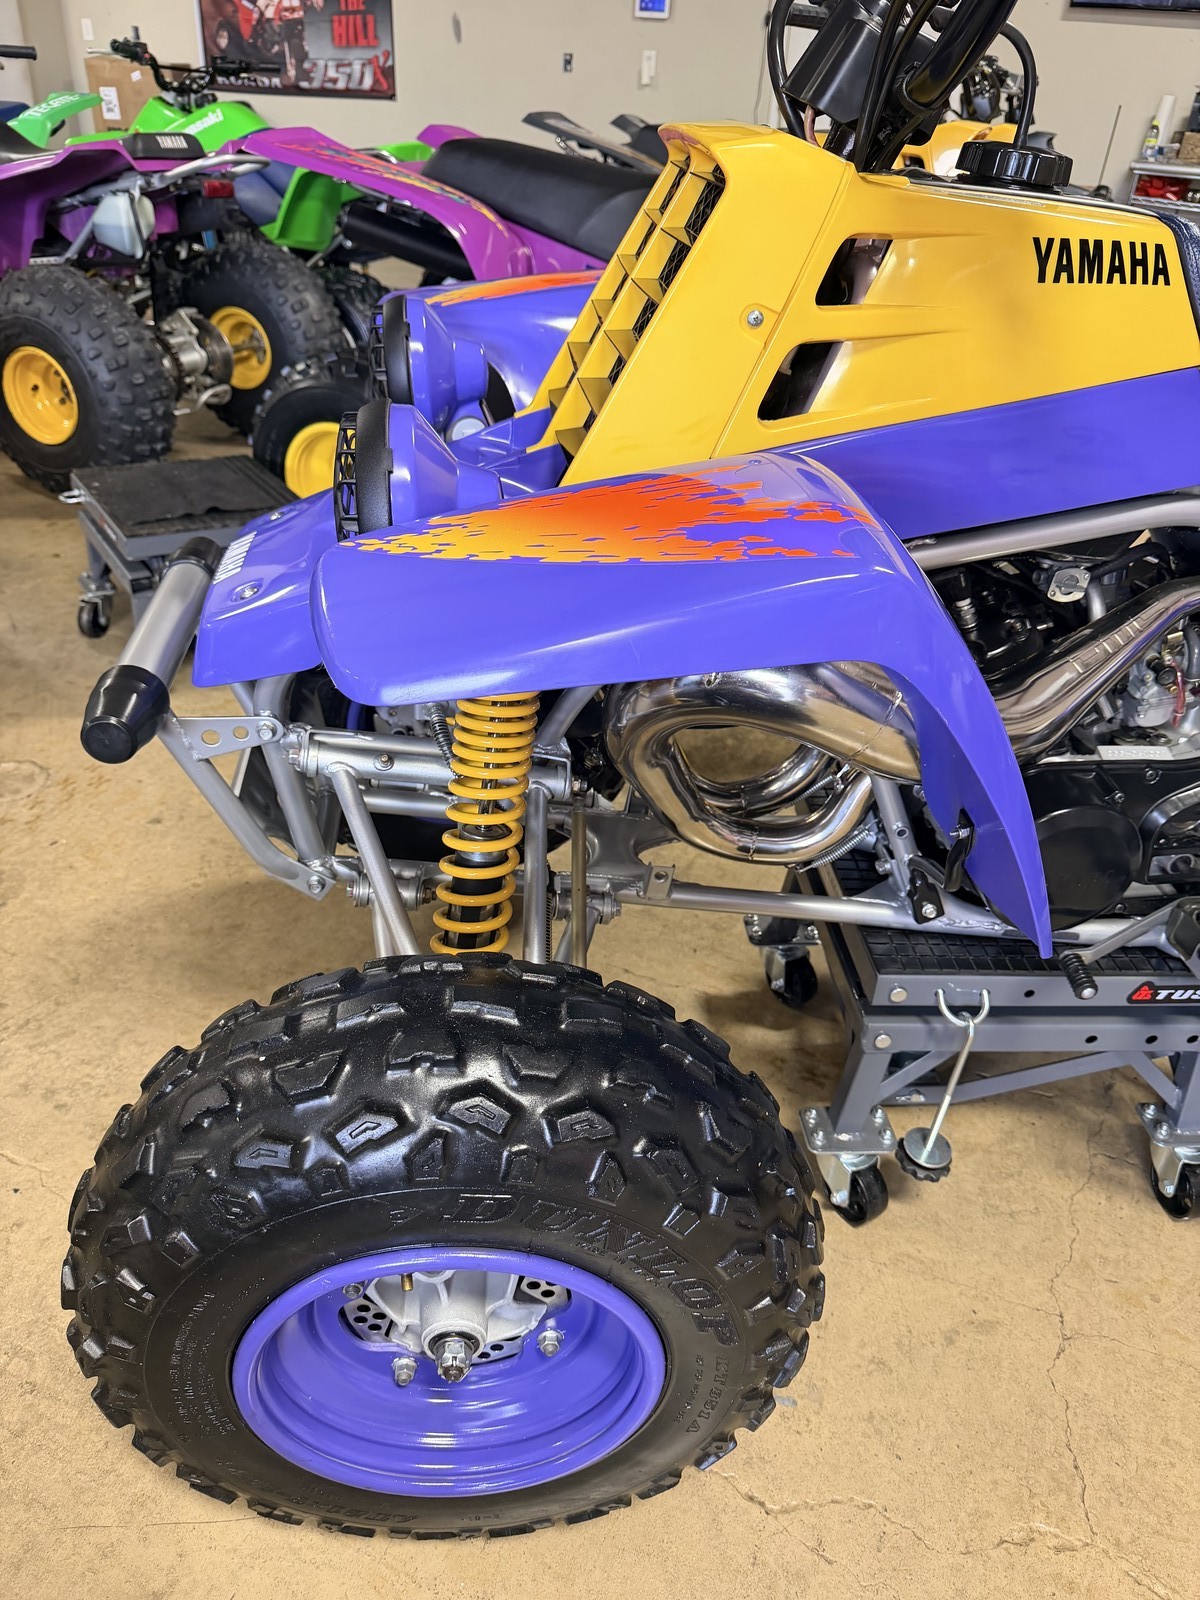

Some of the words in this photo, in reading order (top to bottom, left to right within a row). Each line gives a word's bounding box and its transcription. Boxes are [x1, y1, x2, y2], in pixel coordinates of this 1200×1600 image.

[331, 14, 379, 48] HILL
[1032, 236, 1171, 286] YAMAHA
[441, 1192, 741, 1347] DUNLOP
